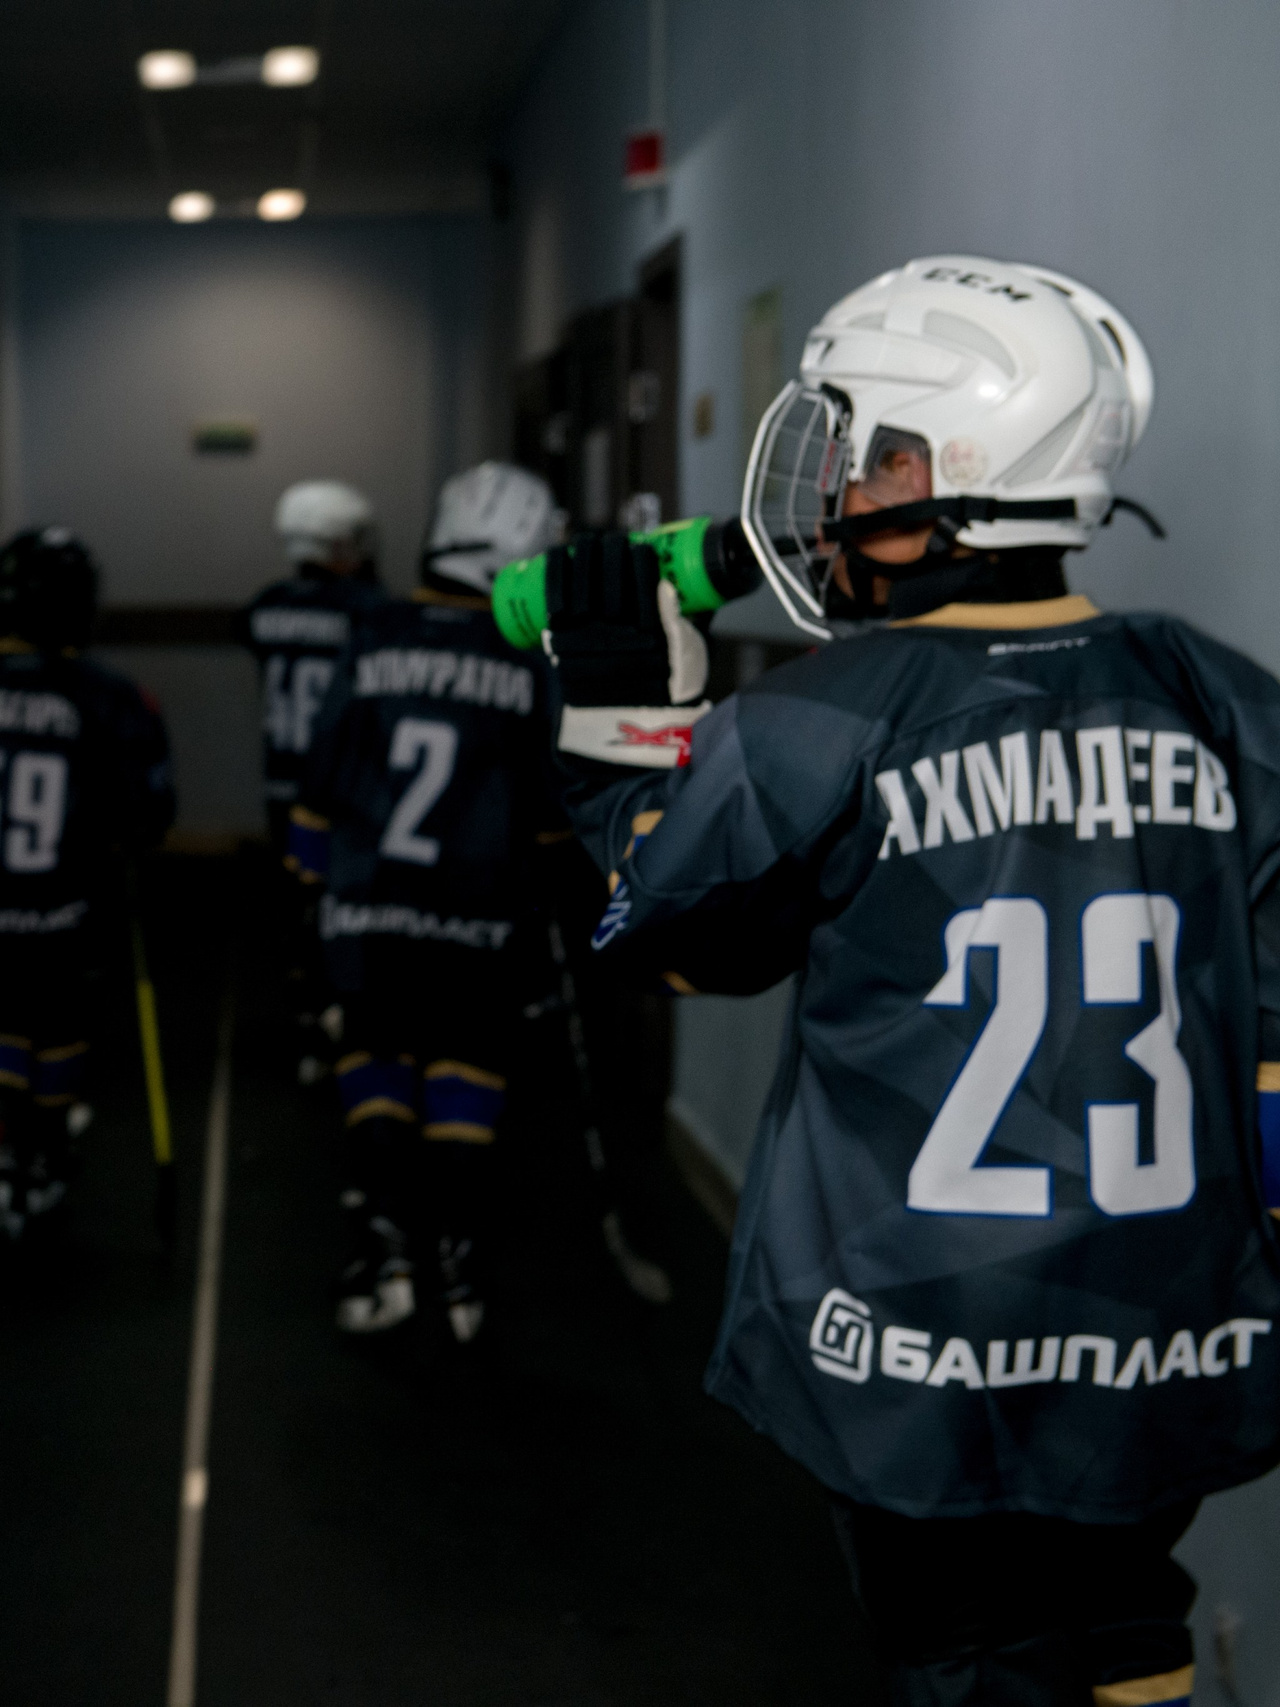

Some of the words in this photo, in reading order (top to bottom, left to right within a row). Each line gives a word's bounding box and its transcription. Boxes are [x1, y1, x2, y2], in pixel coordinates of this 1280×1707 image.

[378, 716, 461, 869] 2
[876, 725, 1237, 860] АХМАДЕЕВ
[907, 893, 1197, 1216] 23
[880, 1318, 1272, 1390] БАШПЛАСТ
